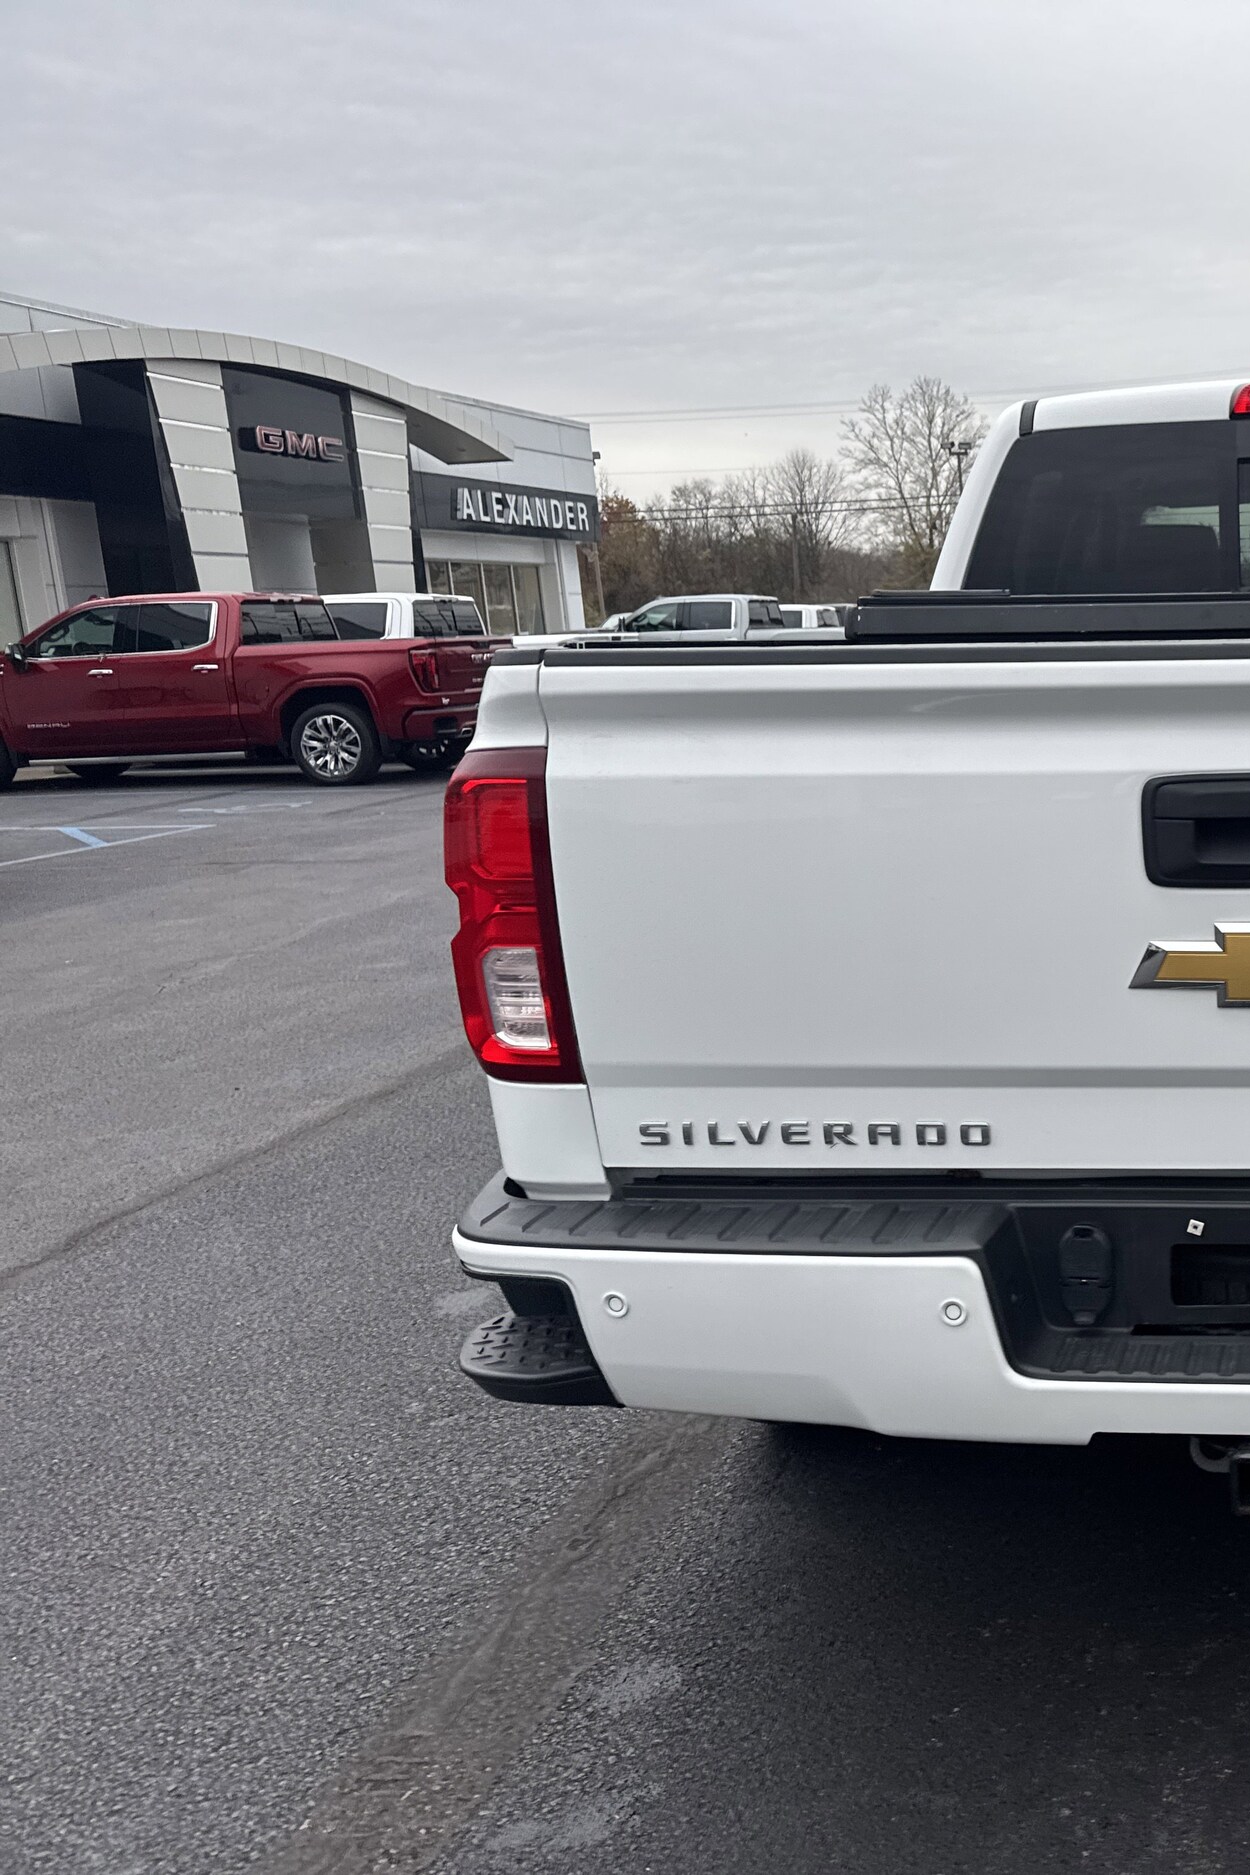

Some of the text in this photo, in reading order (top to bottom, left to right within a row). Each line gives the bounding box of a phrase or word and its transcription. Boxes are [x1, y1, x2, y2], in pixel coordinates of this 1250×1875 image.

[256, 425, 344, 462] GMC
[461, 488, 590, 532] ALEXANDER
[638, 1120, 992, 1147] SILVERADO
